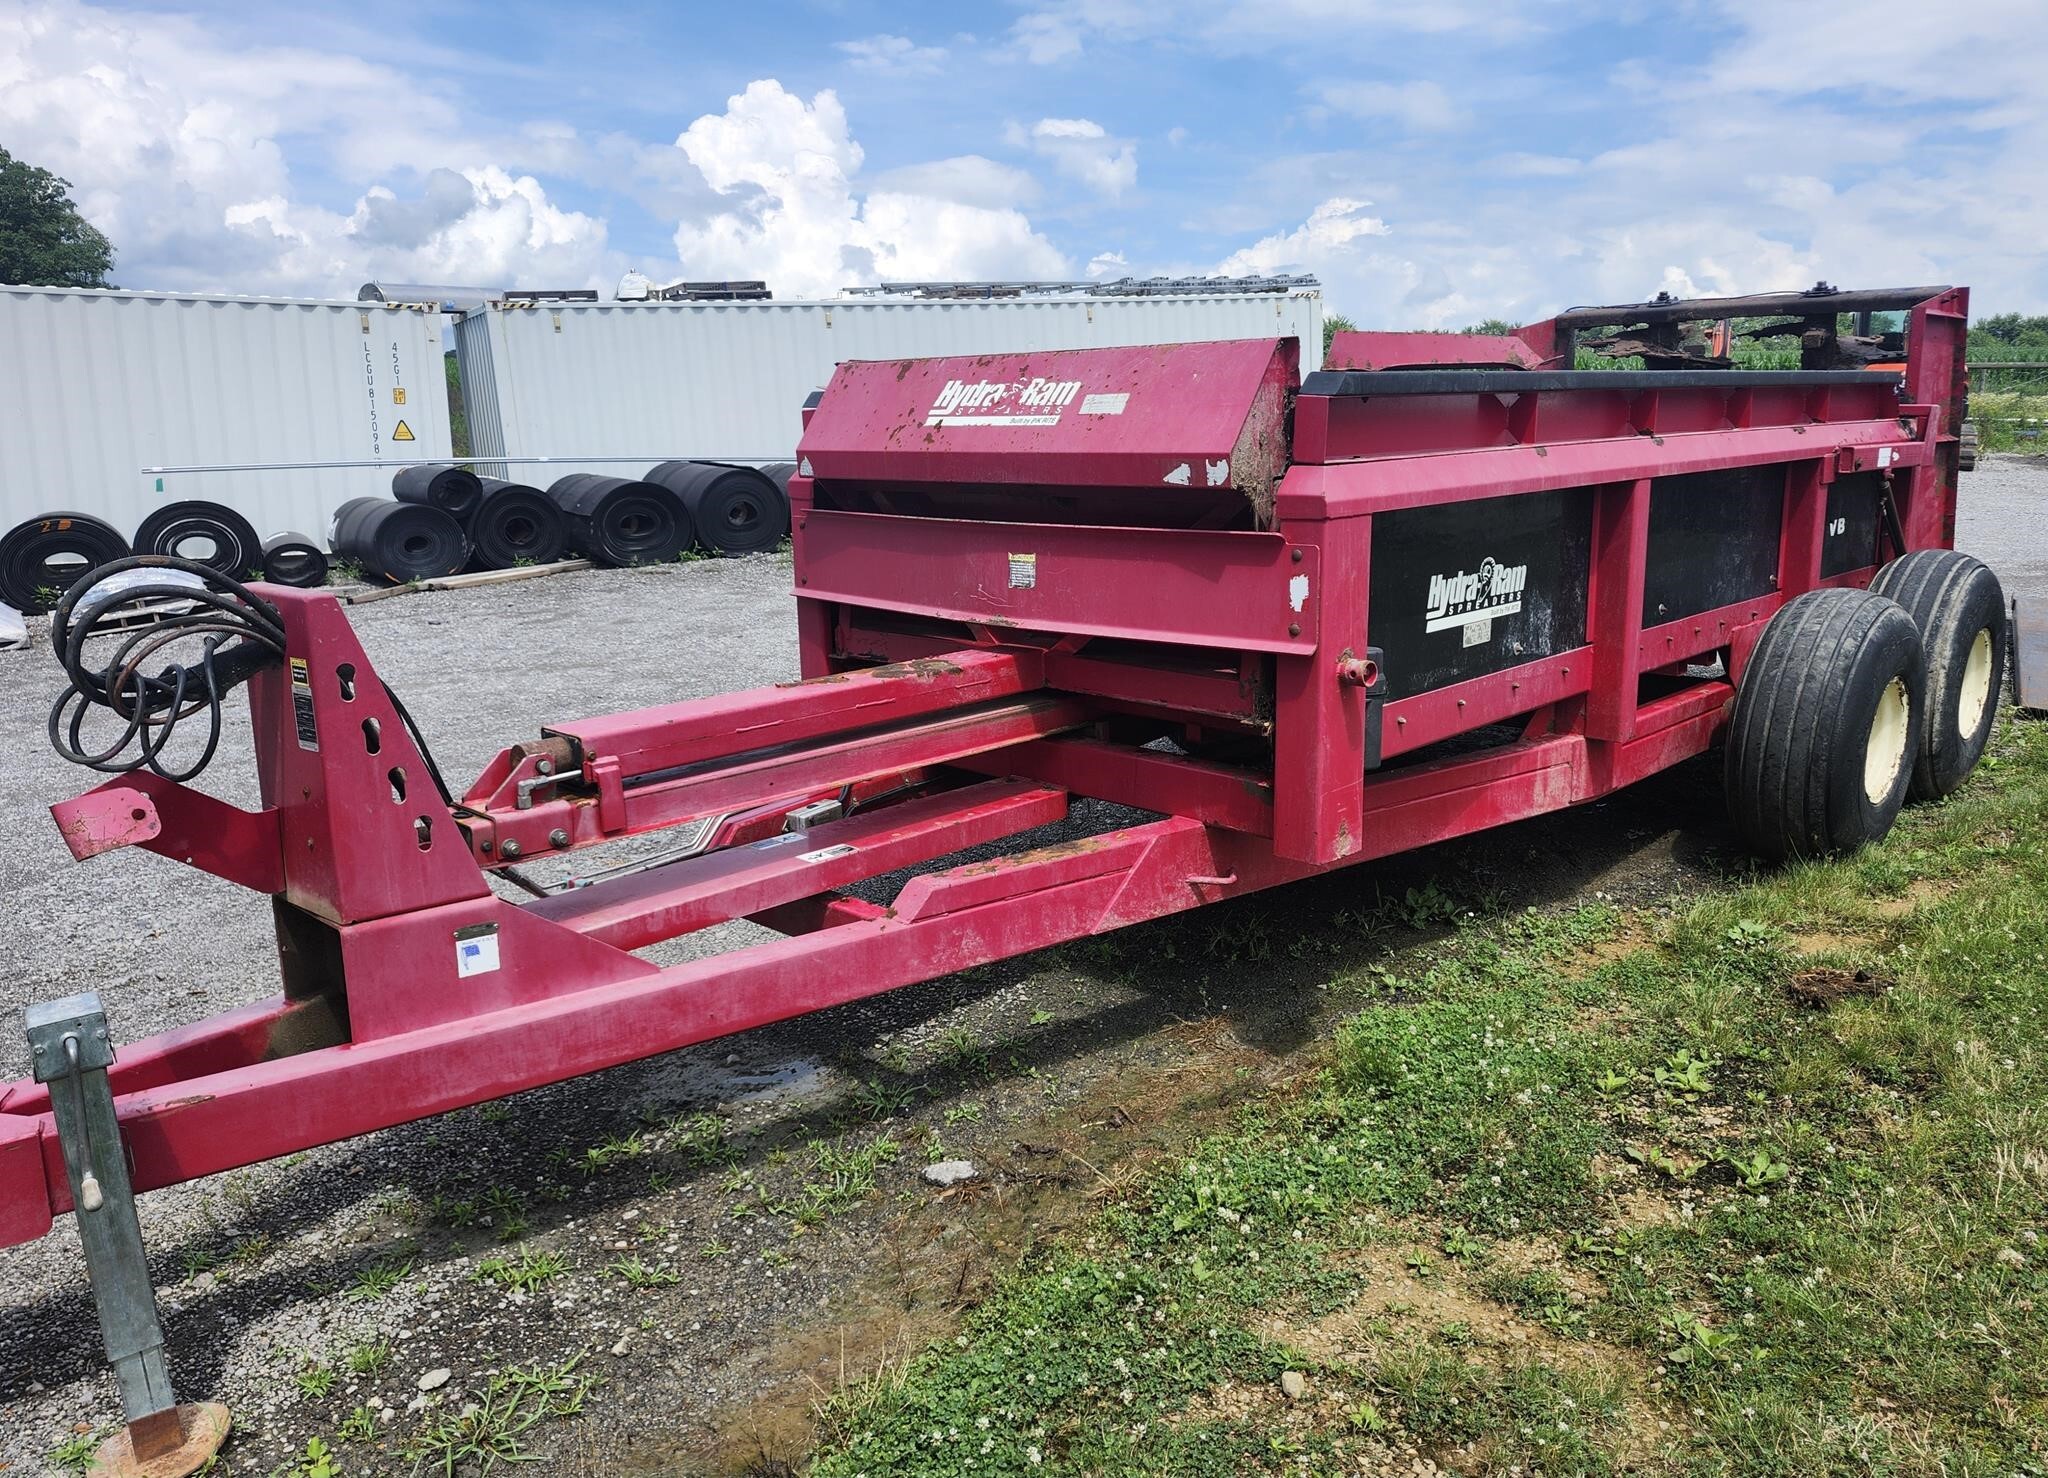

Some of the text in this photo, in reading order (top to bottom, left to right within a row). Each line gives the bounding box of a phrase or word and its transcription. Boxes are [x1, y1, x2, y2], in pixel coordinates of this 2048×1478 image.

[392, 342, 400, 386] 45G1
[928, 379, 1006, 415] Hydra
[1019, 378, 1082, 406] Ram
[1426, 564, 1527, 620] Hydra Ram
[1448, 591, 1522, 616] SPREADERS
